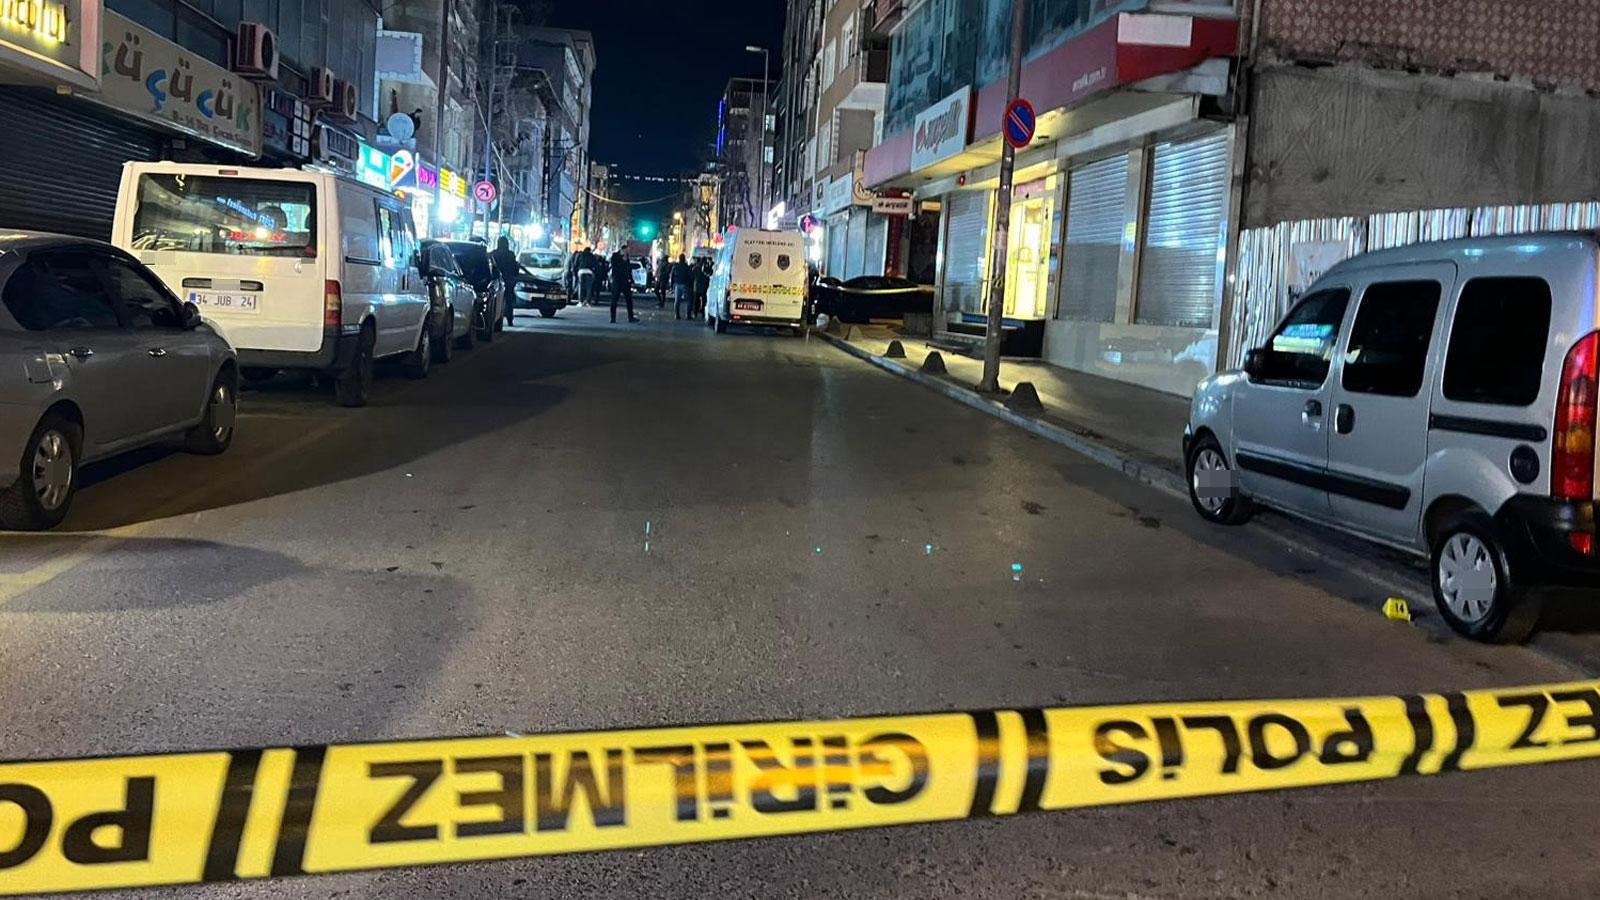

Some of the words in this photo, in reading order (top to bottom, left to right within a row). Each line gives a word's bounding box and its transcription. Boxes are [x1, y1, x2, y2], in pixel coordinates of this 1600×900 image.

[197, 294, 207, 304] 34
[214, 295, 231, 306] JUB
[241, 296, 252, 307] 24
[1095, 706, 1376, 785] POLİS
[366, 732, 932, 845] GİRİLMEZ
